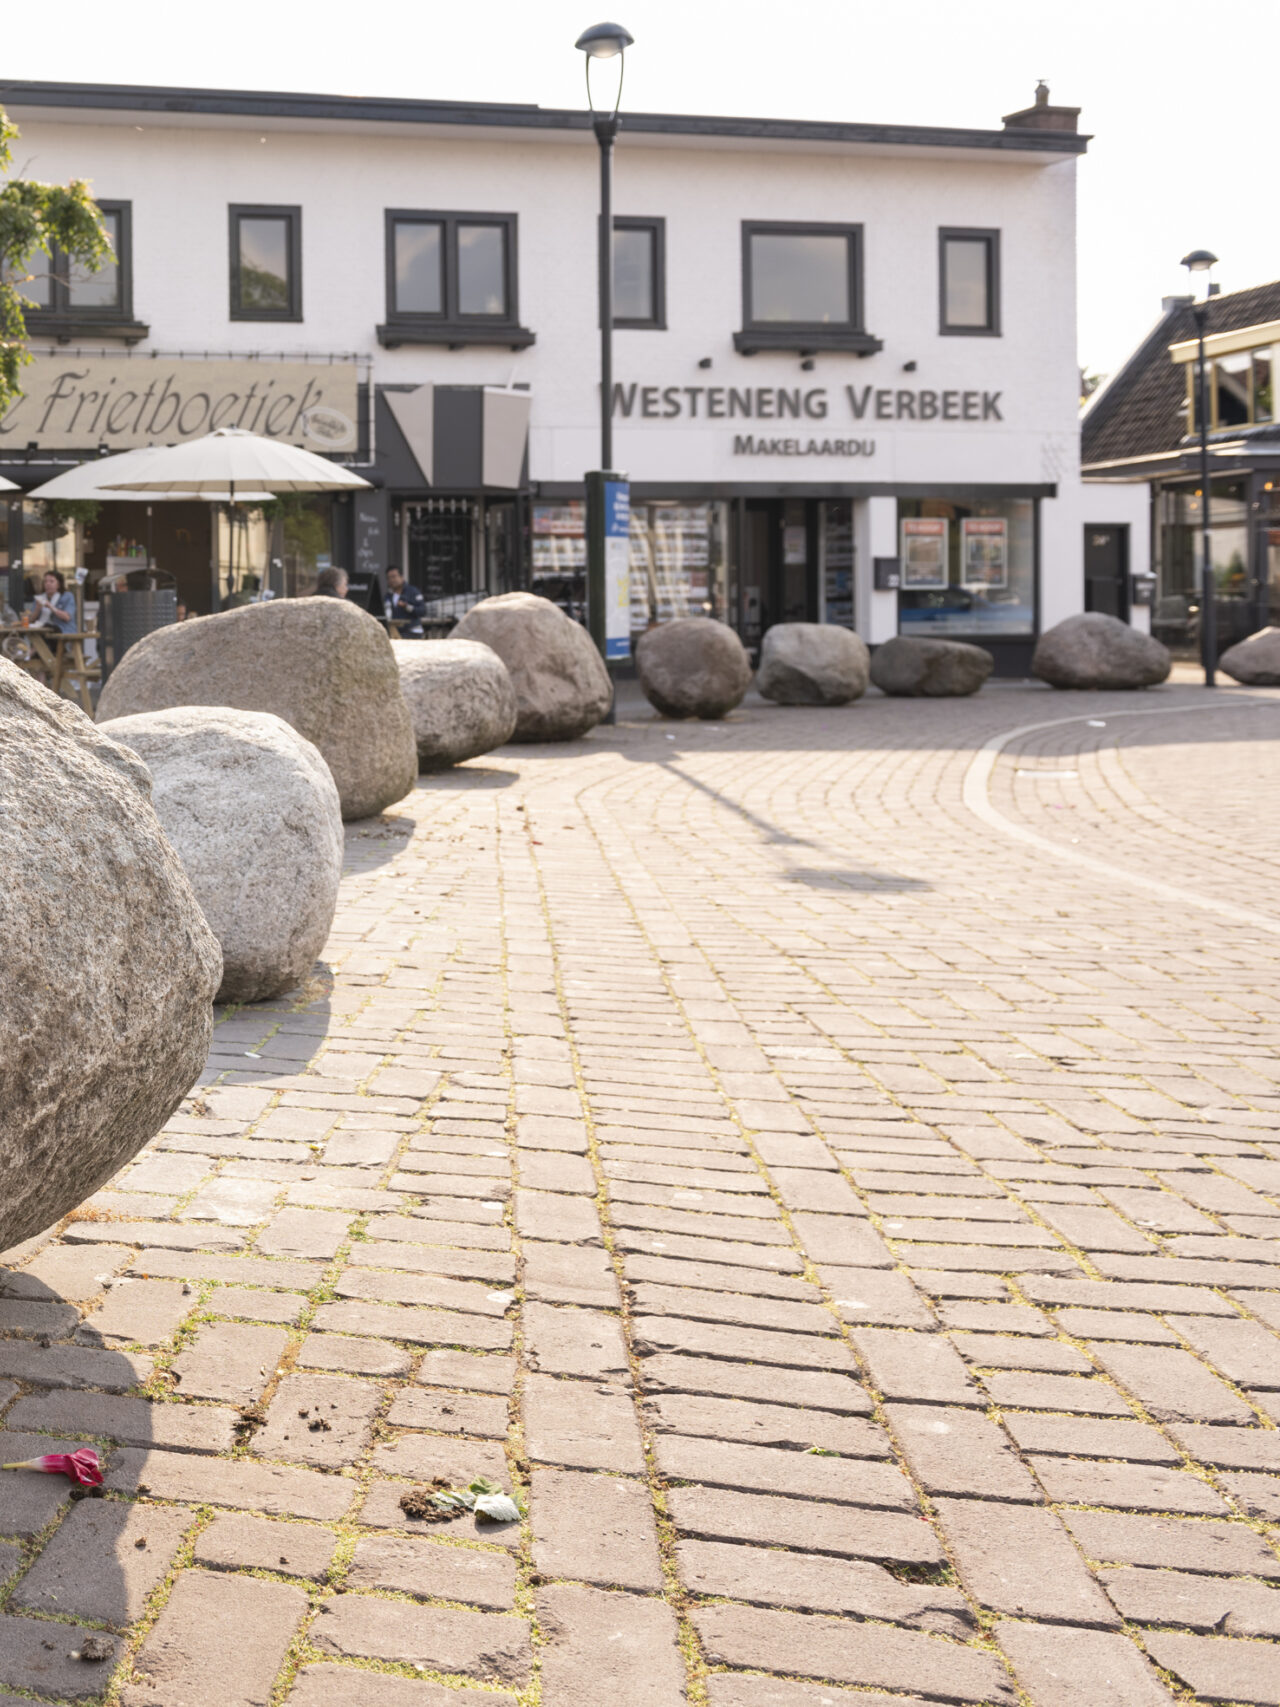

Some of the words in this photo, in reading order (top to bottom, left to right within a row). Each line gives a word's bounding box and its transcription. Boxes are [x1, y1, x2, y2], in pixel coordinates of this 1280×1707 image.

[36, 369, 322, 441] Frietboetiek
[600, 382, 828, 419] WESTENENG
[845, 384, 1003, 421] VERBEEK
